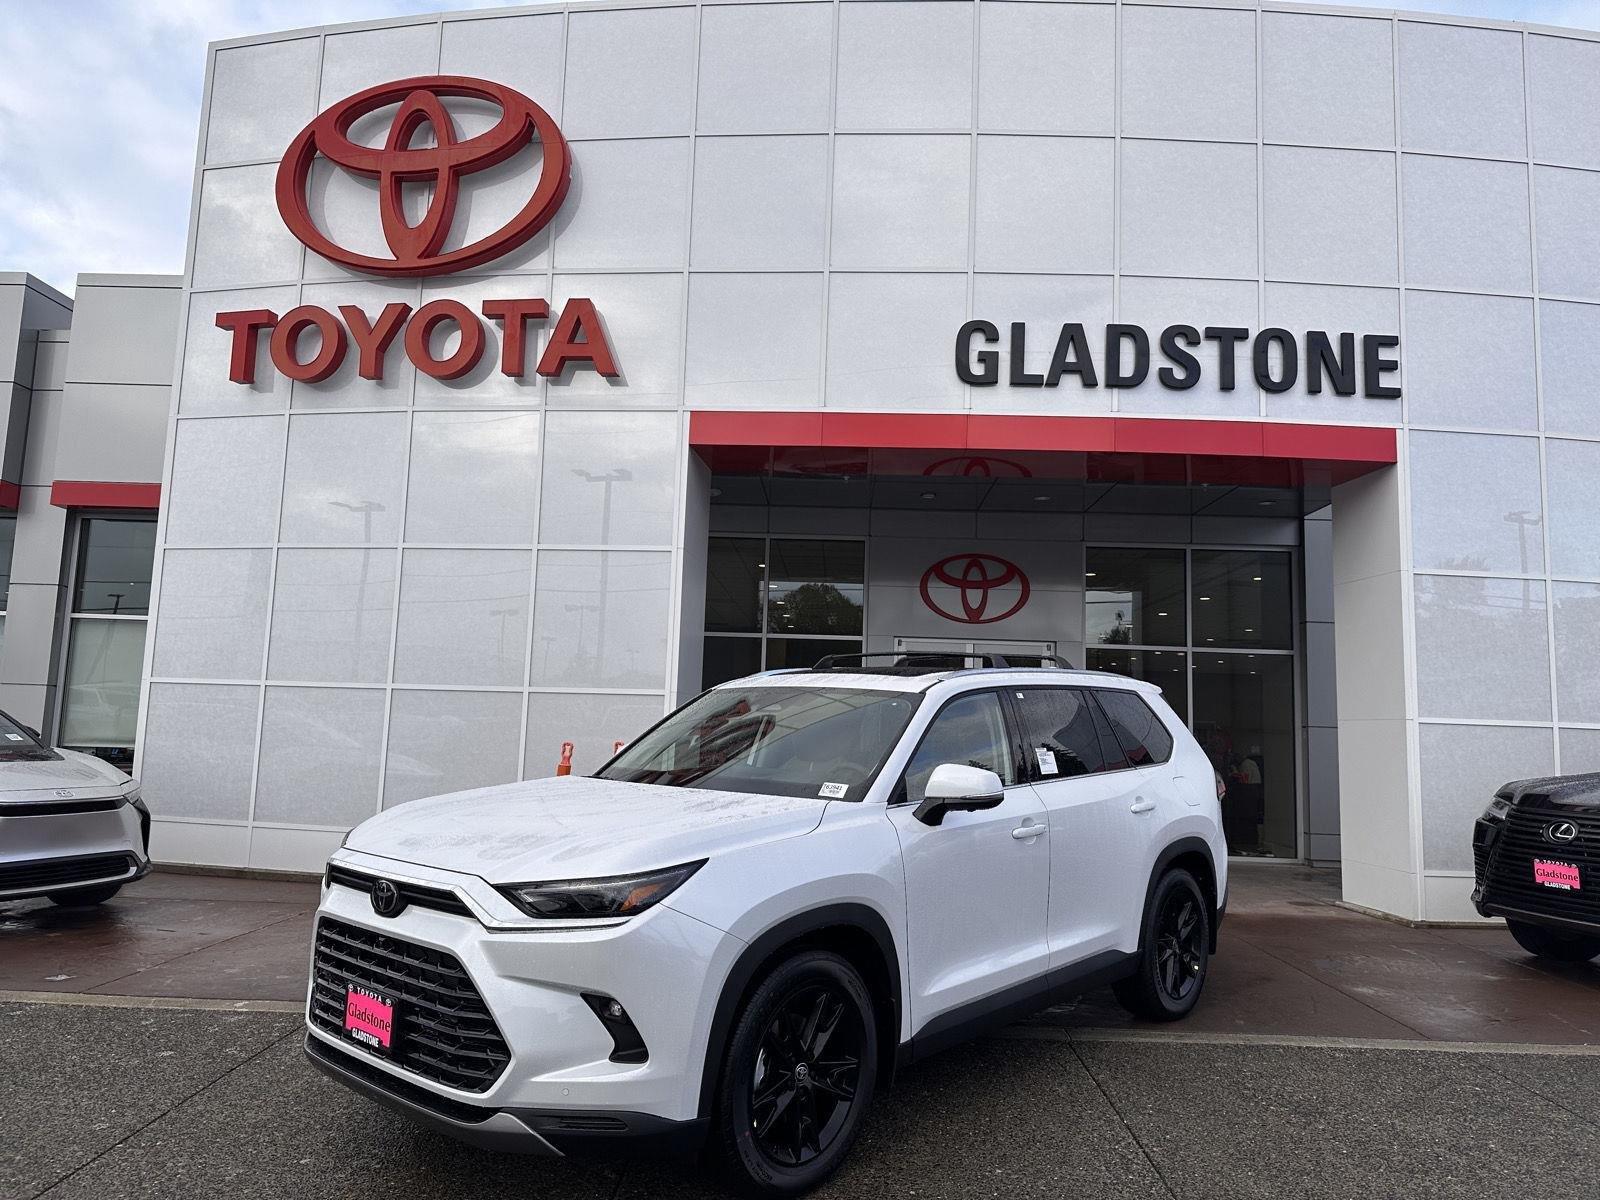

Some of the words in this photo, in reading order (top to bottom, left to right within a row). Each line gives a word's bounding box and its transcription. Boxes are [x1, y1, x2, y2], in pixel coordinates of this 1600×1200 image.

[216, 298, 620, 384] TOYOTA
[955, 319, 1402, 399] GLADSTONE
[1543, 859, 1568, 867] TOYOTA
[1536, 868, 1579, 881] Gladstone
[1544, 881, 1571, 890] GLADSTONE
[357, 987, 382, 1003] TOYOTA
[348, 1002, 391, 1032] Gladstone
[352, 1028, 380, 1047] GLADSTONE
